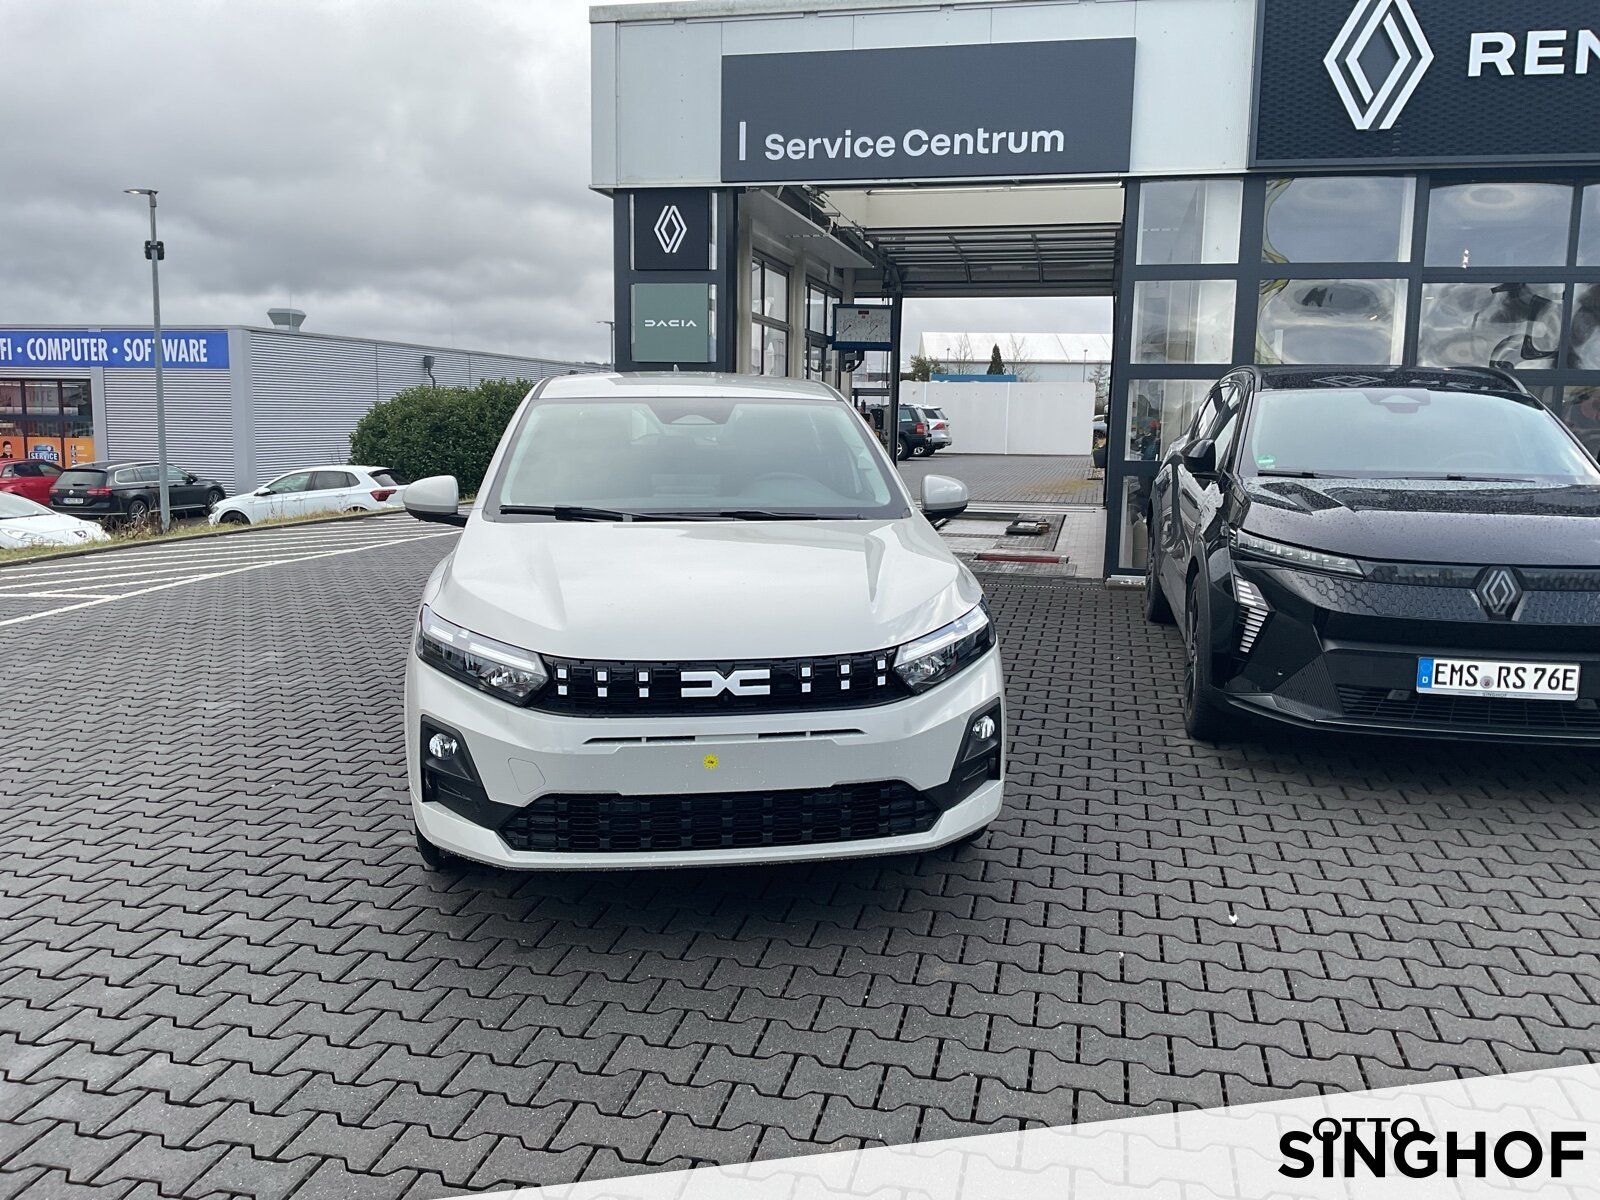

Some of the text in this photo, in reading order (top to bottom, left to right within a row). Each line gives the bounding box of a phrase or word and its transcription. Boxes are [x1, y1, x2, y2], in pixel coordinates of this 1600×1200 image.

[764, 127, 1065, 161] Service Centrum
[644, 319, 698, 328] DACIA
[26, 338, 108, 361] COMPUTER
[124, 338, 207, 362] SOFWARE
[30, 452, 59, 461] SERVICE
[1434, 663, 1479, 687] EMS
[1497, 666, 1526, 689] RS
[1533, 668, 1576, 692] 76E
